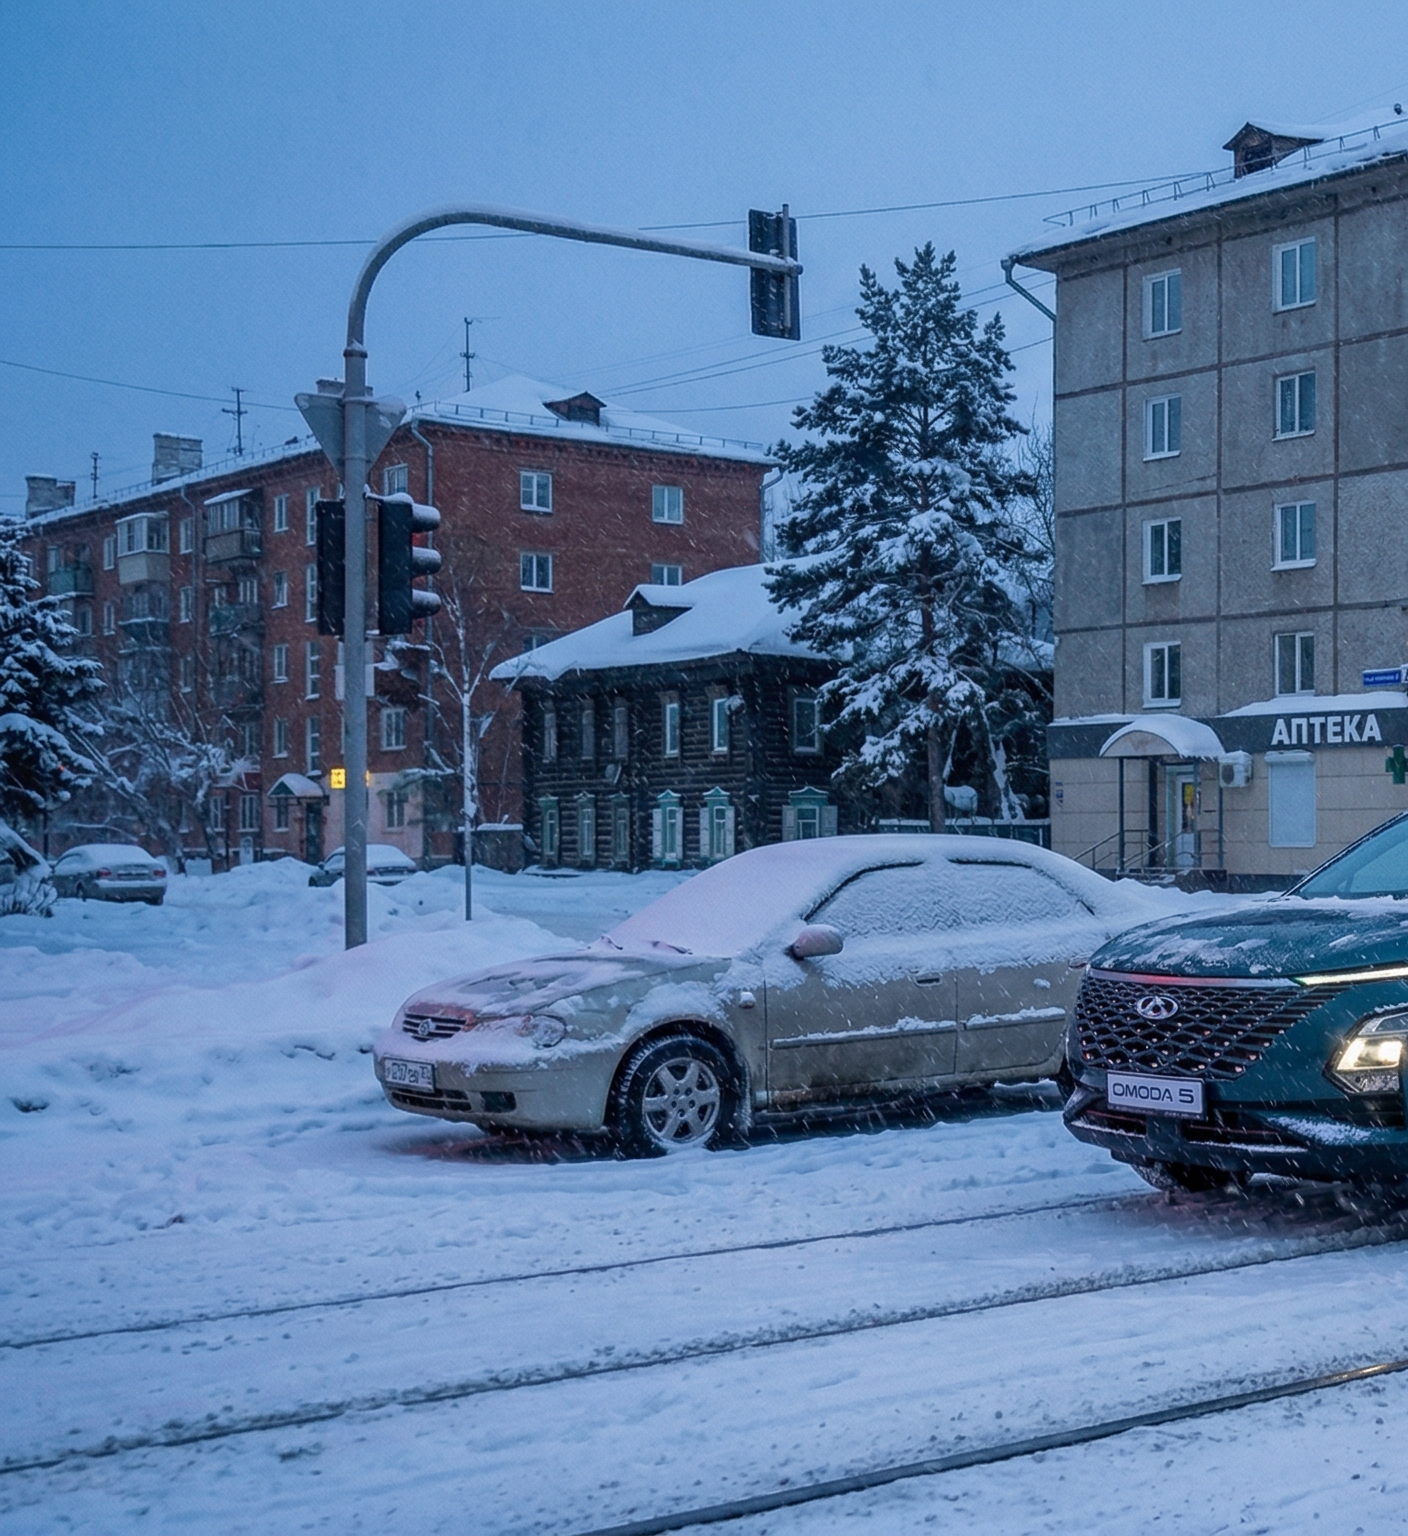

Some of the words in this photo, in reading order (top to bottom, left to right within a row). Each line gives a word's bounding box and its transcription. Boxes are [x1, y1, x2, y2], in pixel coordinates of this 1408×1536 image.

[1270, 713, 1382, 745] АПТЕКА
[1112, 1082, 1173, 1102] OMODA
[1178, 1088, 1195, 1104] 5
